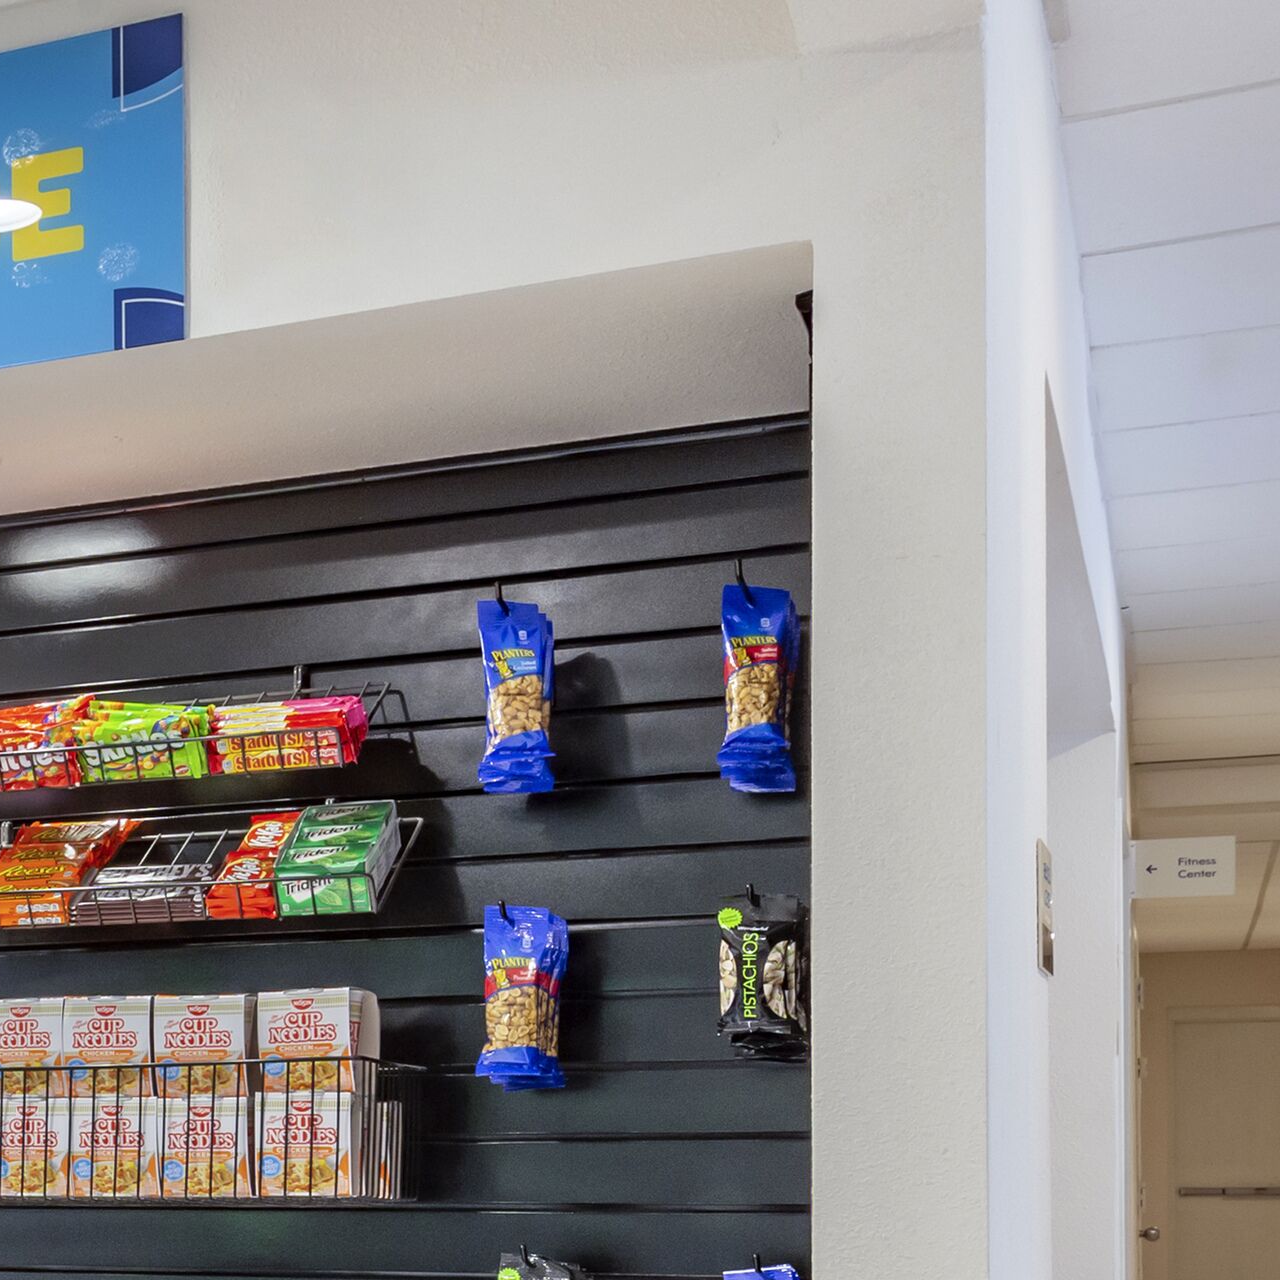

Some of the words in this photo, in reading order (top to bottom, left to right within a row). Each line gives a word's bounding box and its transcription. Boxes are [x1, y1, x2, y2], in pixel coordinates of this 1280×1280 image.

[731, 635, 777, 648] PLANTERS
[491, 648, 535, 662] PLANTERS
[84, 728, 185, 766] Skittles
[305, 824, 360, 839] Trident
[291, 846, 347, 860] Trident
[1178, 857, 1216, 866] Fitness
[1178, 869, 1216, 878] Center
[283, 877, 333, 896] Trident
[491, 957, 536, 970] PLANTE
[742, 932, 759, 1018] PISTACHIOS
[3, 1018, 38, 1034] CUP
[88, 1018, 124, 1033] CUP
[179, 1018, 218, 1034] CUP
[283, 1011, 323, 1028] CUP
[73, 1031, 138, 1048] NOODLES
[164, 1031, 232, 1049] NOODLES
[268, 1024, 338, 1044] NOODLES
[183, 1119, 221, 1134] CUP
[283, 1114, 323, 1130] CUP
